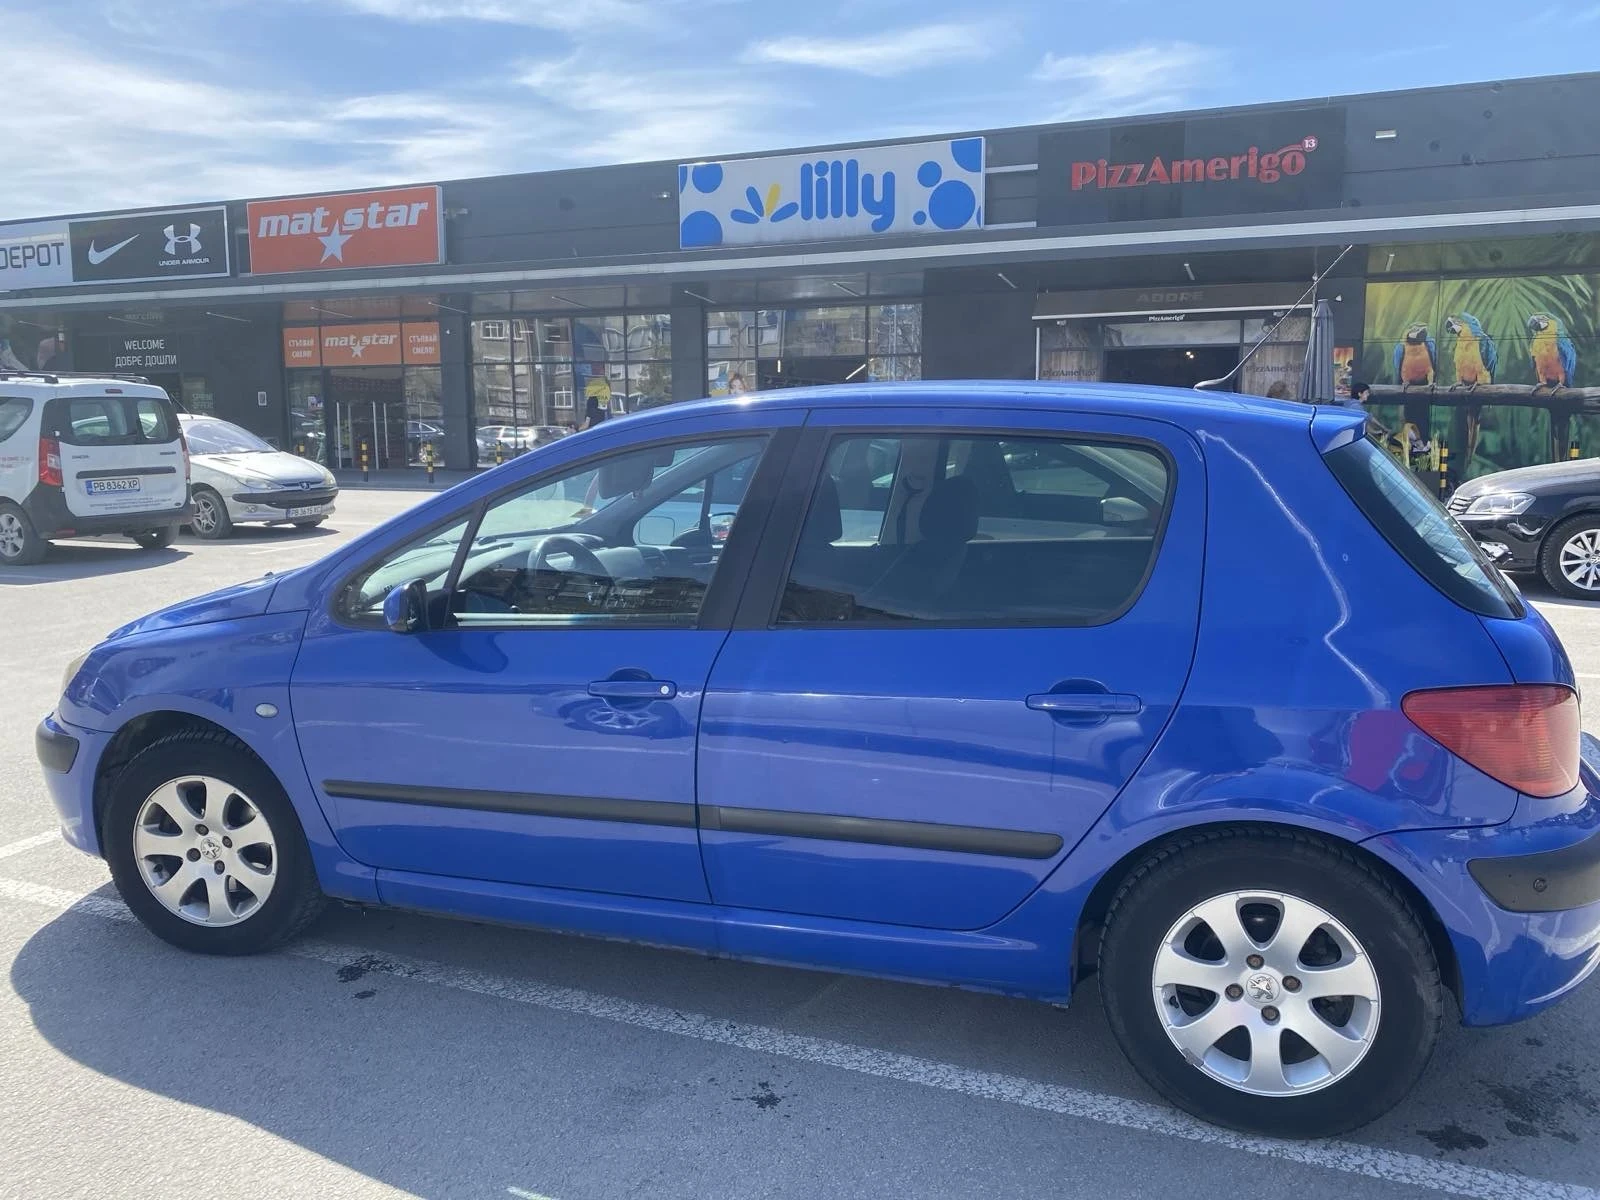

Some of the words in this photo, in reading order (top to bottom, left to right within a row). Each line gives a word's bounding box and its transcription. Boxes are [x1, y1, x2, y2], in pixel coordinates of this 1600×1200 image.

[1304, 138, 1317, 149] 13
[1071, 146, 1306, 190] PizzAmerigo
[801, 159, 896, 233] lilly
[257, 206, 330, 238] mat
[341, 202, 429, 231] star
[0, 243, 65, 270] DEPOT
[182, 257, 210, 265] ARMOUR
[124, 339, 165, 350] WELCOME
[325, 335, 357, 347] mat
[361, 333, 398, 346] star
[115, 355, 143, 368] ДОБРЕ
[144, 354, 177, 367] ДОШЛИ
[93, 481, 106, 492] PB
[107, 480, 127, 490] 8362
[128, 479, 138, 489] XP
